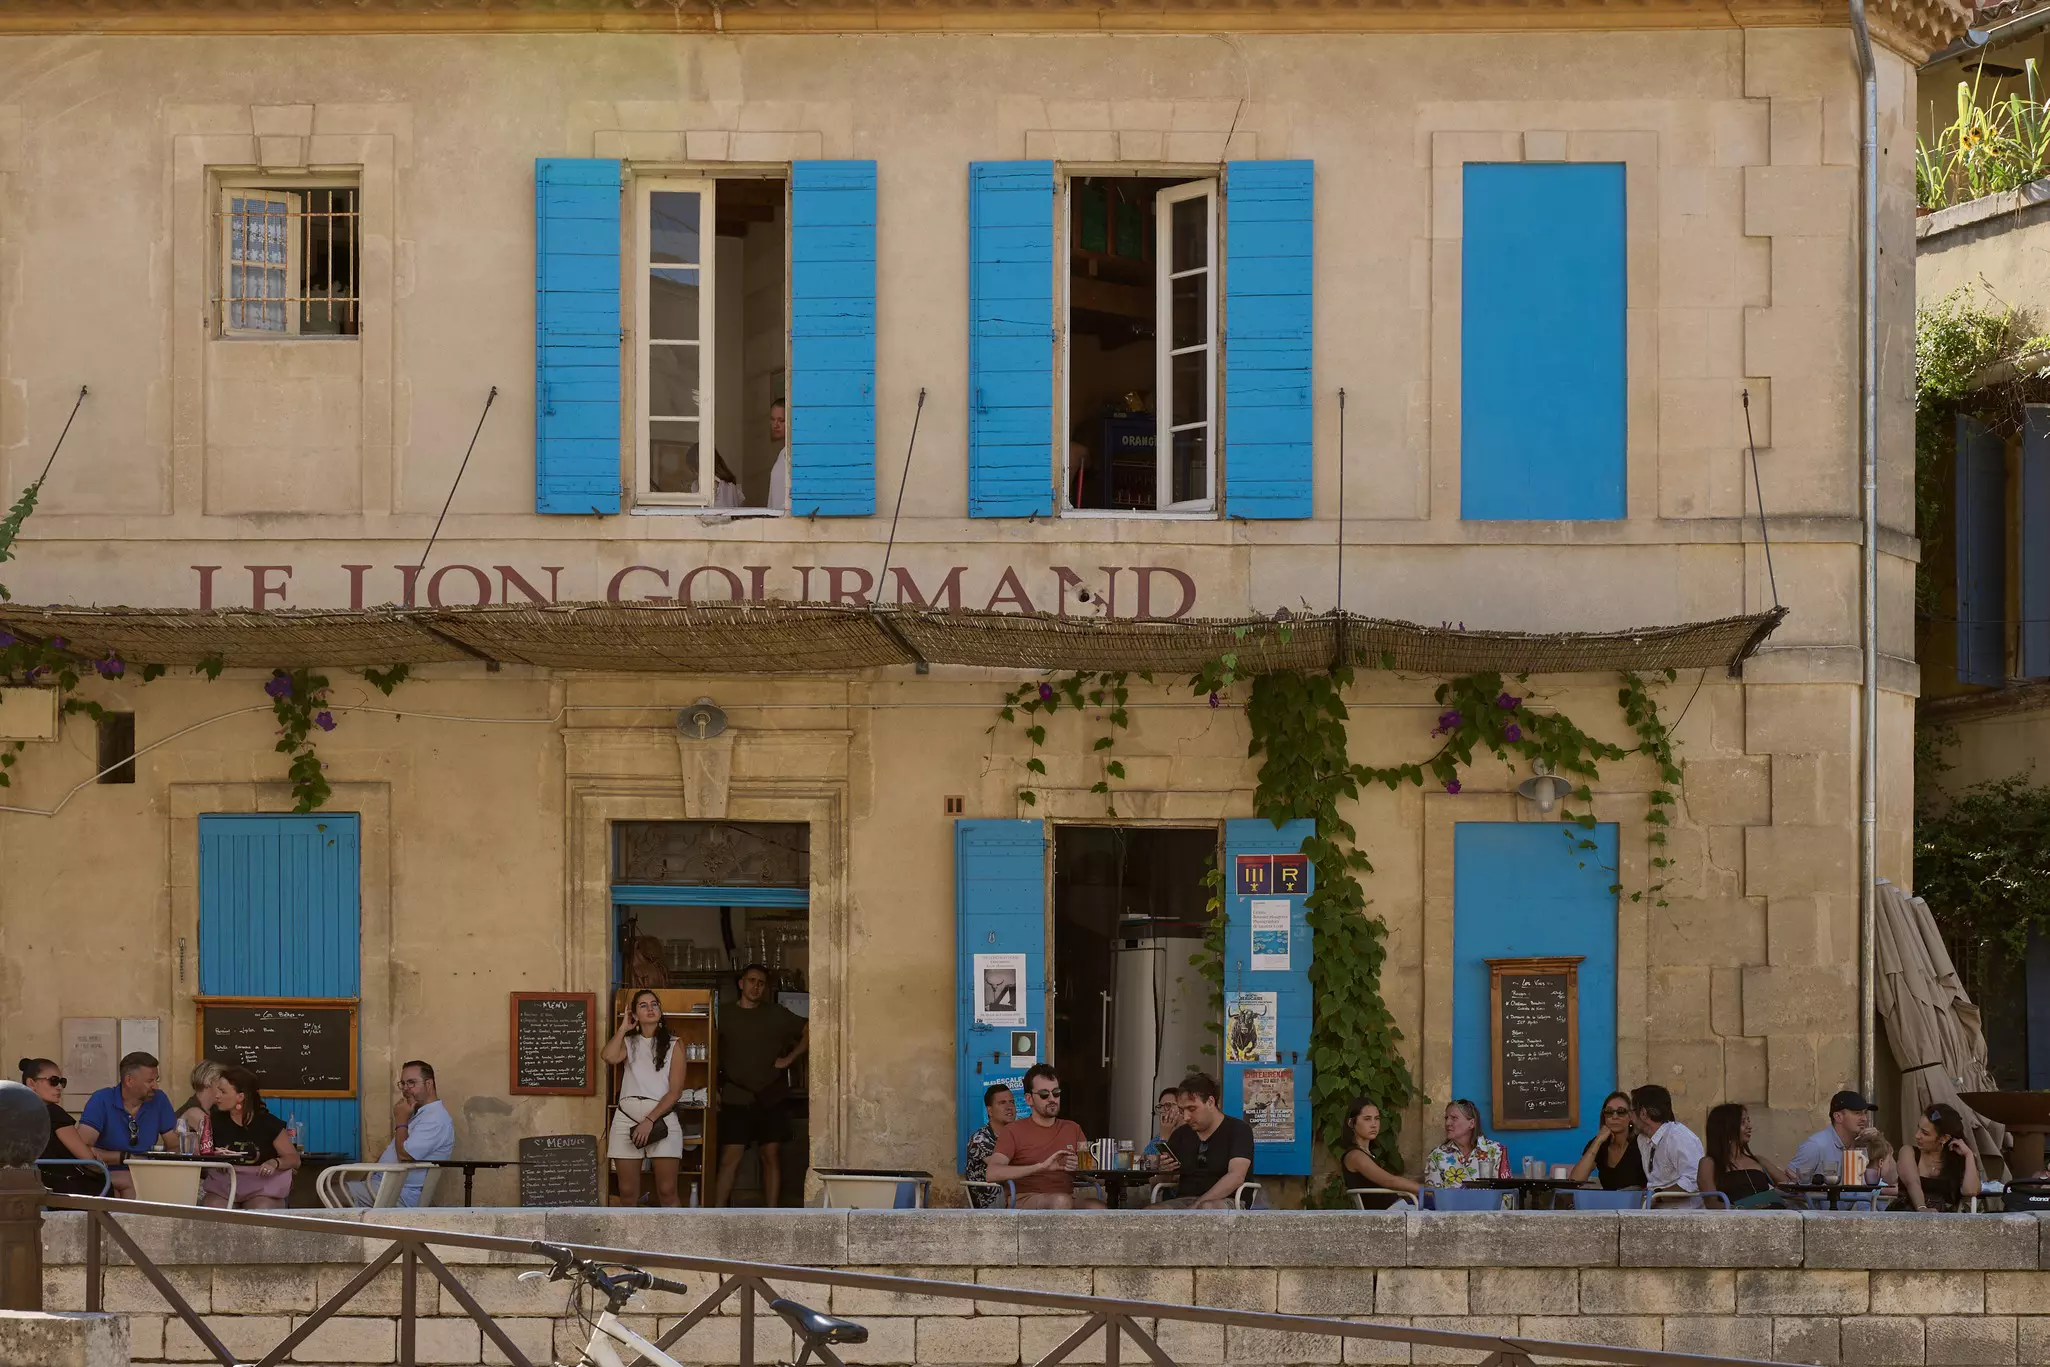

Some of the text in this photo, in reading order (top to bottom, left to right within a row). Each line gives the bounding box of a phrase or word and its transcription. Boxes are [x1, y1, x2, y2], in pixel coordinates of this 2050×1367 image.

[1122, 435, 1157, 446] ORANG
[607, 565, 1196, 619] GOURMAND
[543, 1001, 568, 1010] MENU
[546, 1138, 577, 1148] MENU
